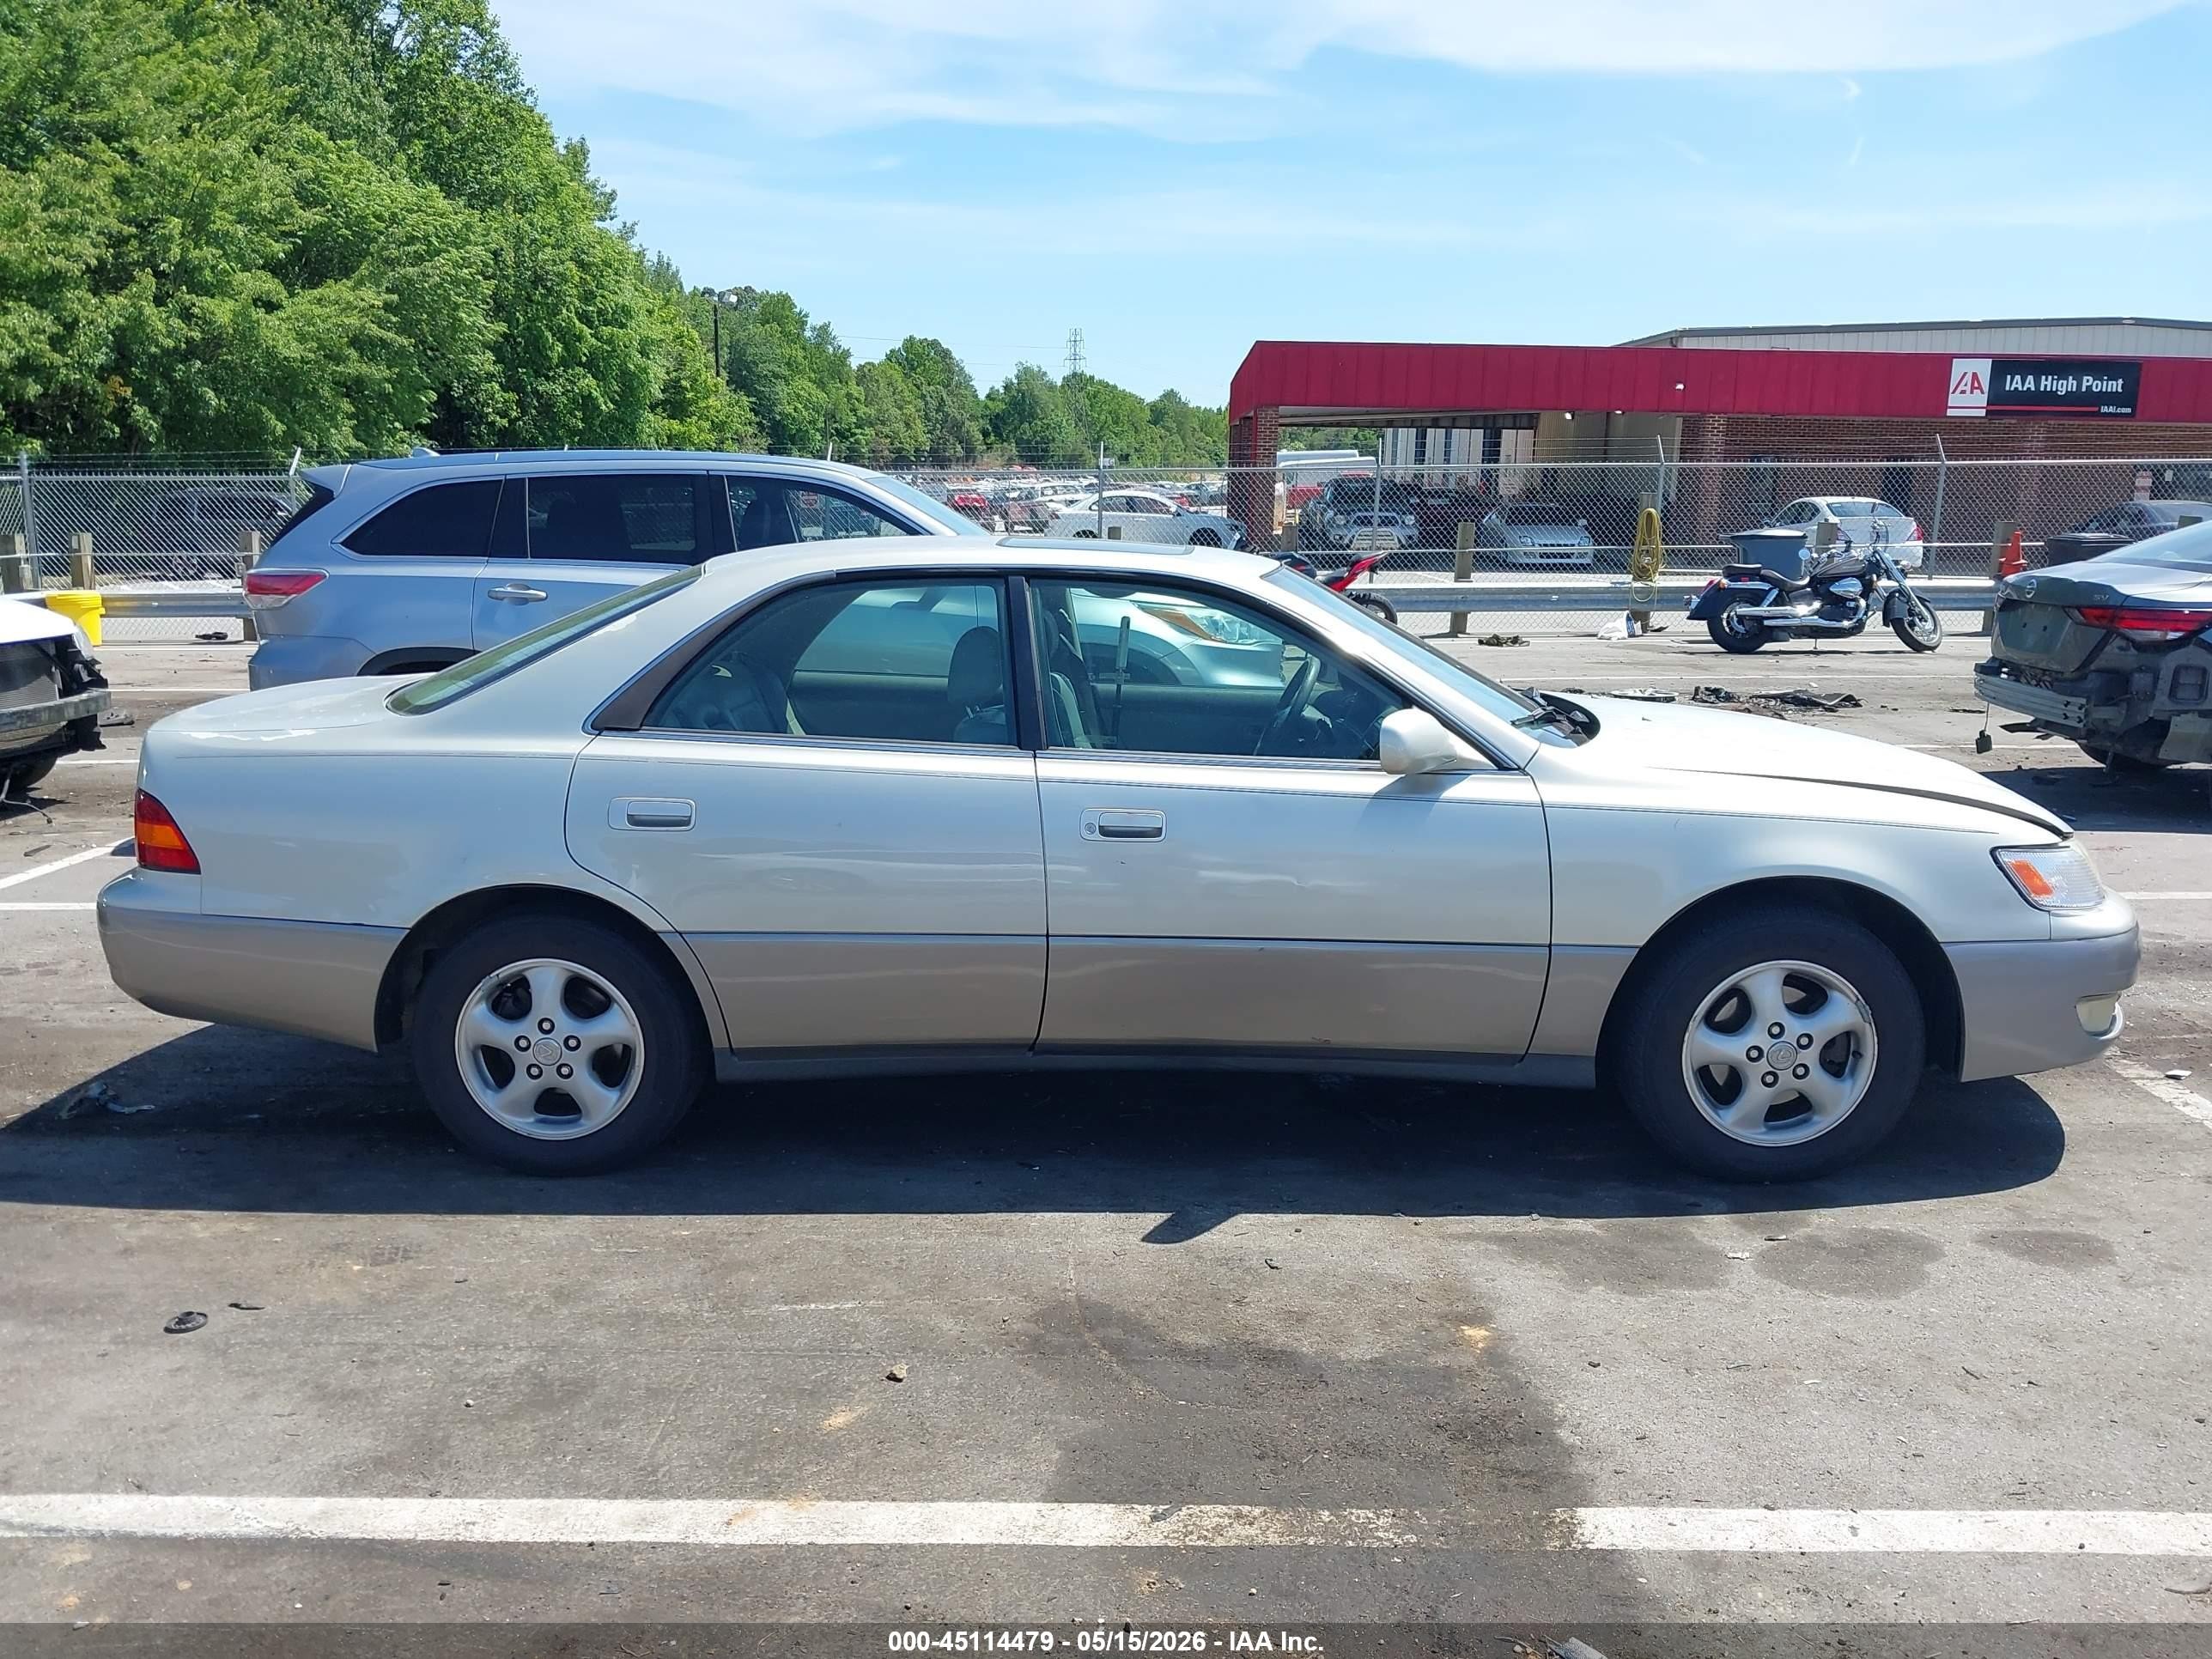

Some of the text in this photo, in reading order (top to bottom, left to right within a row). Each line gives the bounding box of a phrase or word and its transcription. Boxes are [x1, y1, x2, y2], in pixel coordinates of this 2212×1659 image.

[2005, 374, 2124, 395] IAA High Point
